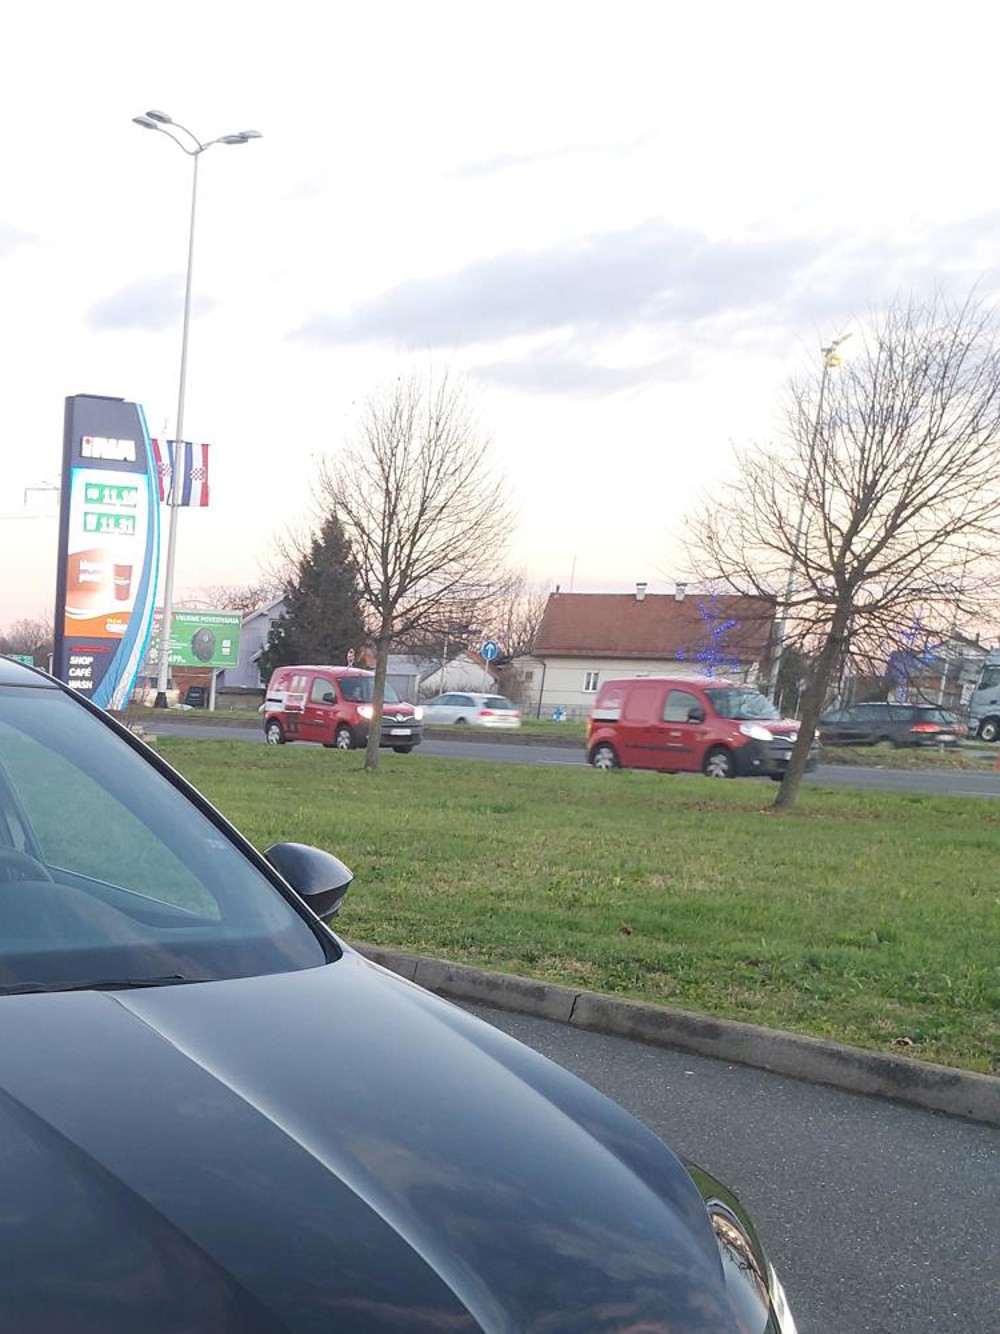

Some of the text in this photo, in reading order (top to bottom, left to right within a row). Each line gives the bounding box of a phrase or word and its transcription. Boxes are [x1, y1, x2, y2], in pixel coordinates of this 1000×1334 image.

[69, 656, 94, 665] SHOP
[68, 666, 92, 677] CAFÉ
[68, 679, 93, 689] WASH
